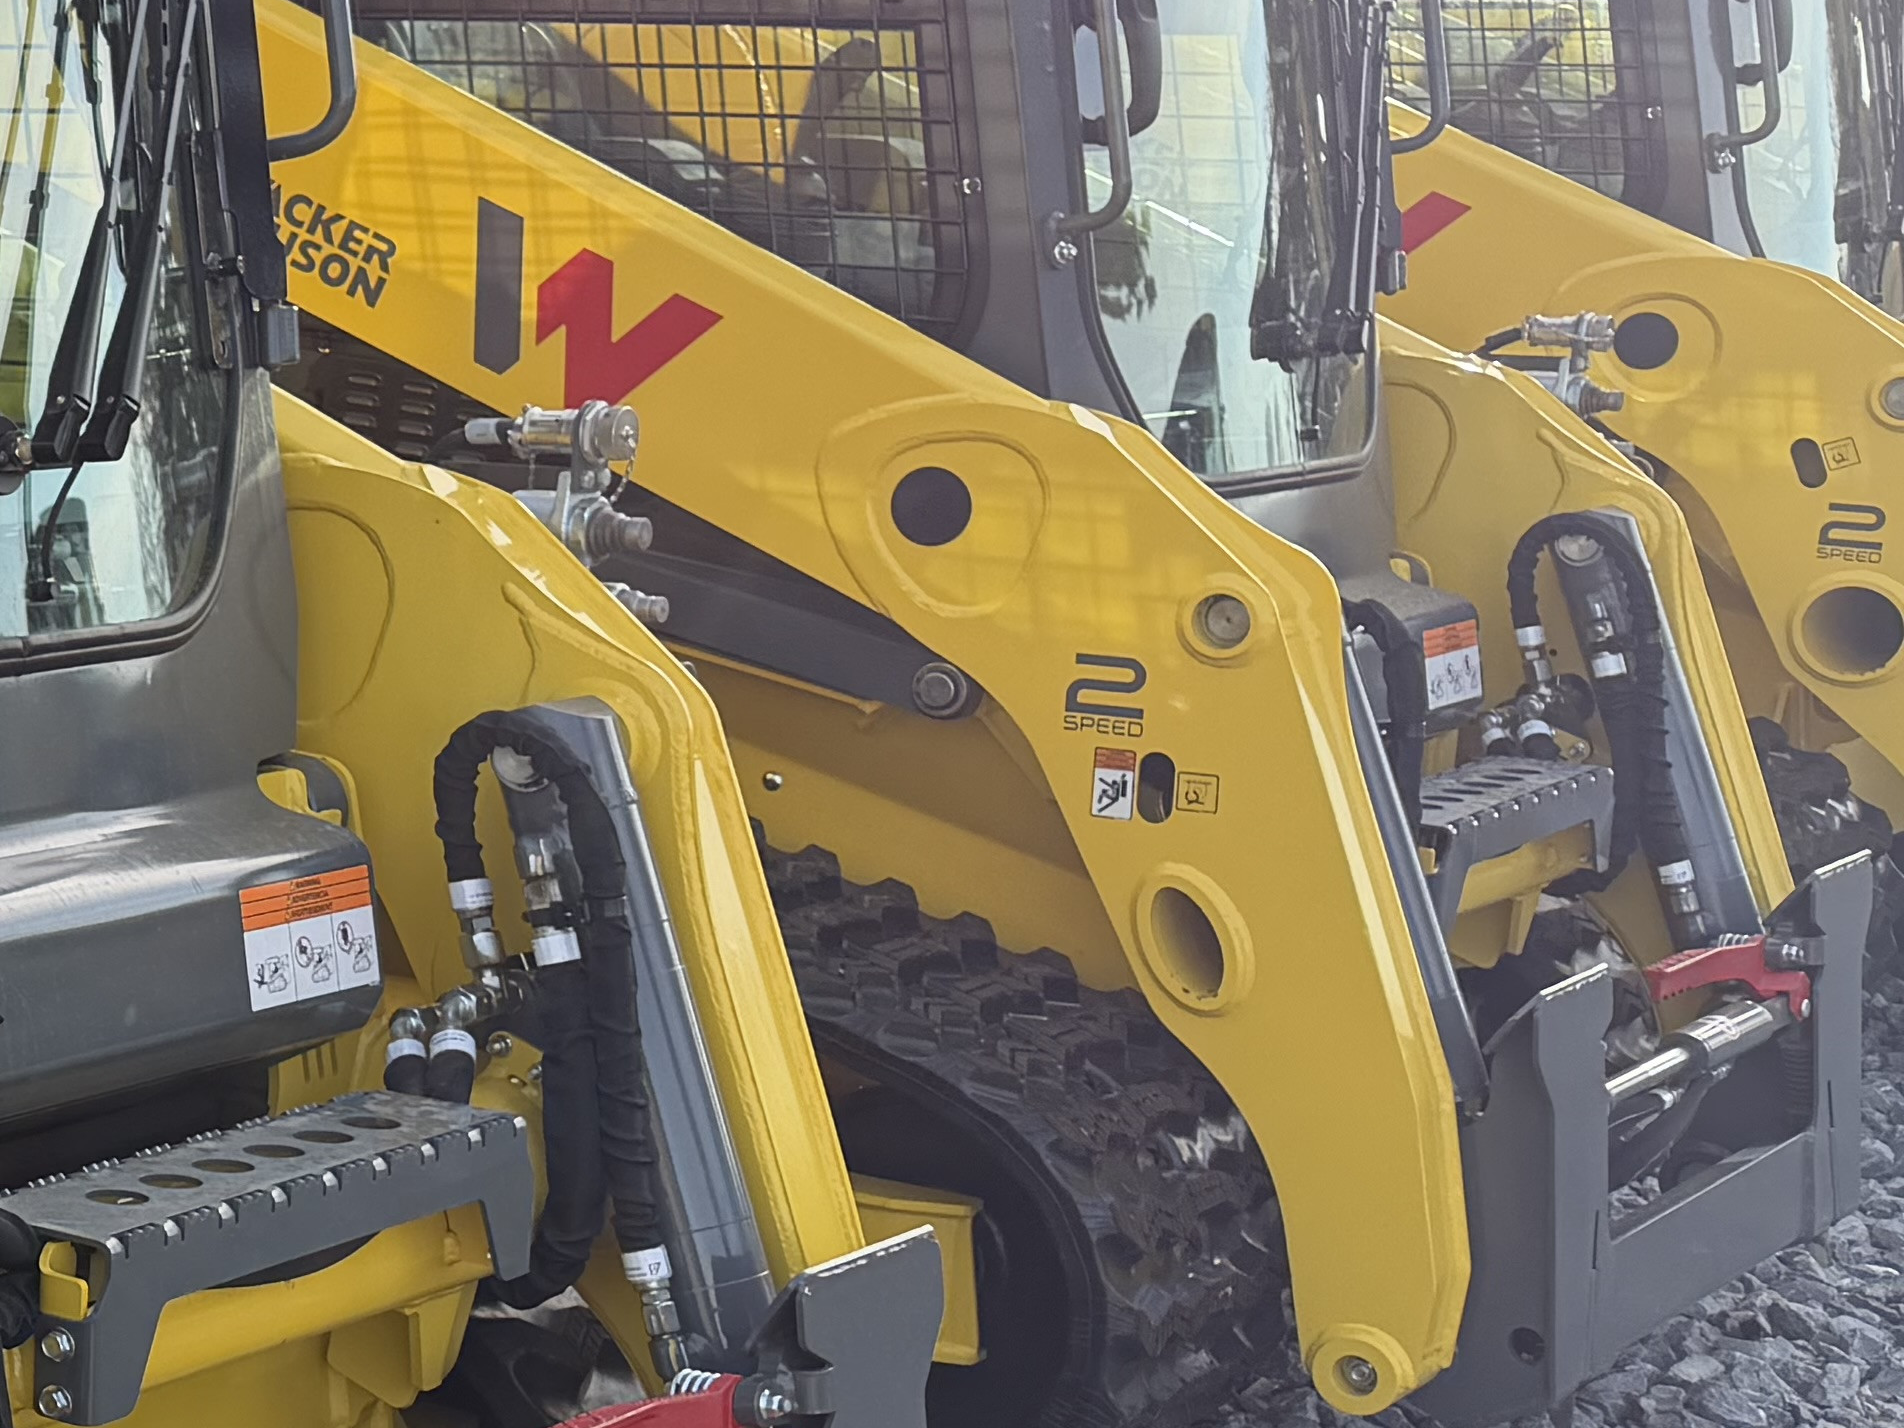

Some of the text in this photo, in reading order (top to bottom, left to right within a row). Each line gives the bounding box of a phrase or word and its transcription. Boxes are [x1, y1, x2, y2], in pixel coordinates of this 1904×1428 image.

[1818, 502, 1886, 551] 2
[1816, 546, 1882, 564] SPEED
[1064, 652, 1147, 720] 2
[1063, 714, 1145, 739] SPEED
